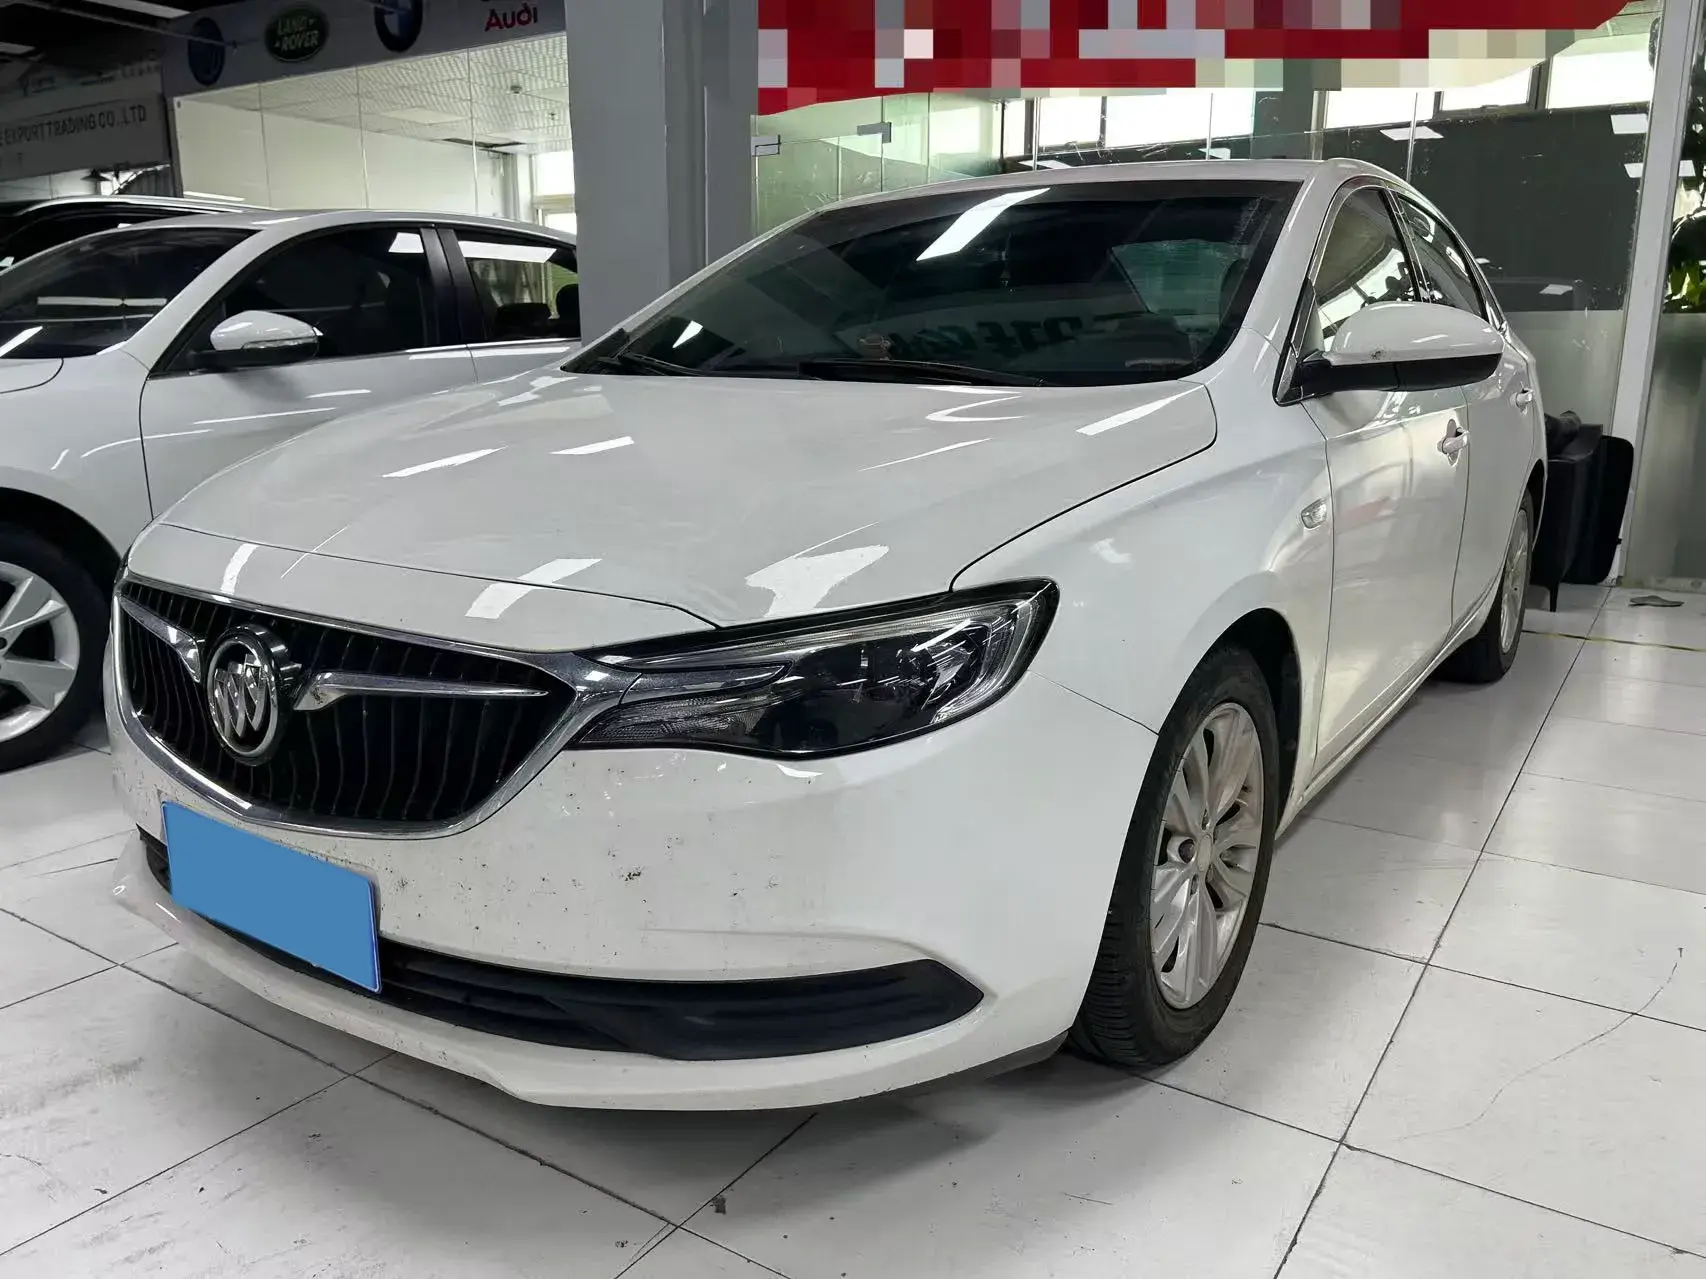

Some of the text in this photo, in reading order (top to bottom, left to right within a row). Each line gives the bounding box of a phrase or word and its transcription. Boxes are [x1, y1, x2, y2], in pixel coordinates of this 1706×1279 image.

[277, 15, 307, 36] LAND
[484, 3, 538, 32] Audi
[281, 30, 319, 52] ROVER
[5, 123, 45, 145] EXPORT
[45, 112, 96, 138] TRADING
